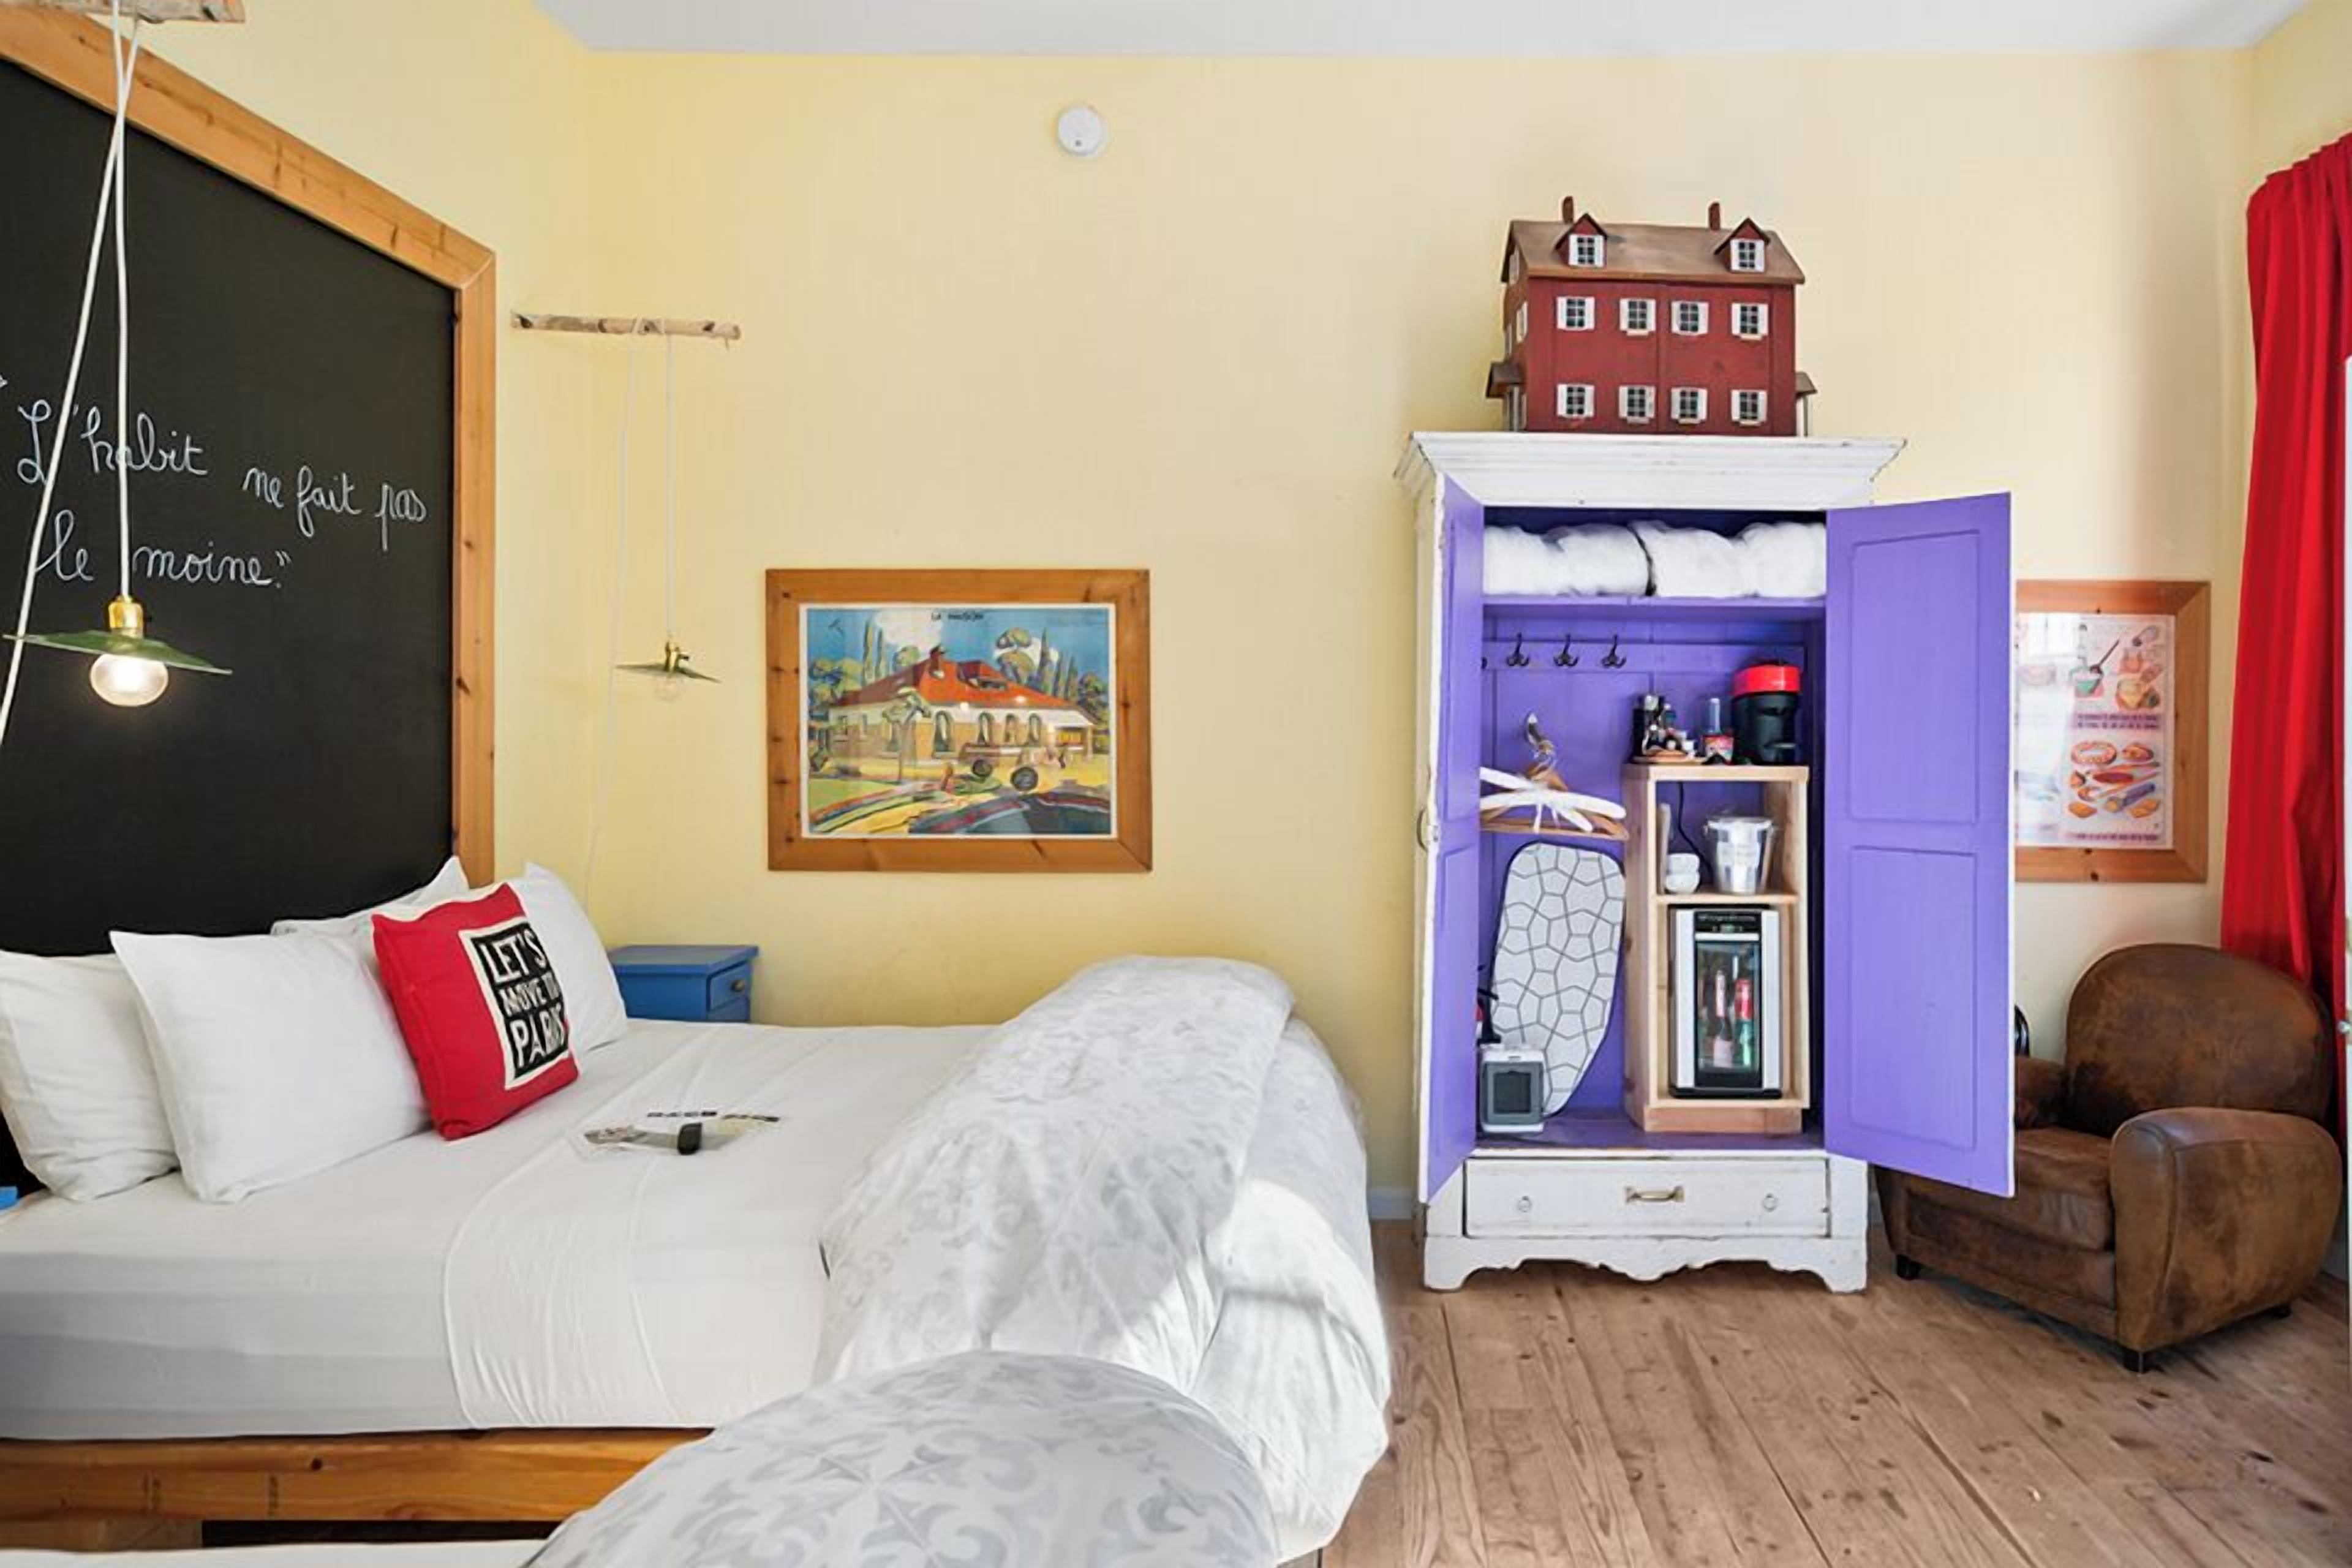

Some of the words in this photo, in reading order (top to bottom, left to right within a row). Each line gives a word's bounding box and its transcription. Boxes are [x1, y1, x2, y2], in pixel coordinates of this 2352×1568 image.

[243, 467, 284, 508] ne
[296, 466, 362, 538] fait
[374, 483, 428, 551] pas
[35, 510, 94, 581] le
[480, 929, 547, 984] LET'S
